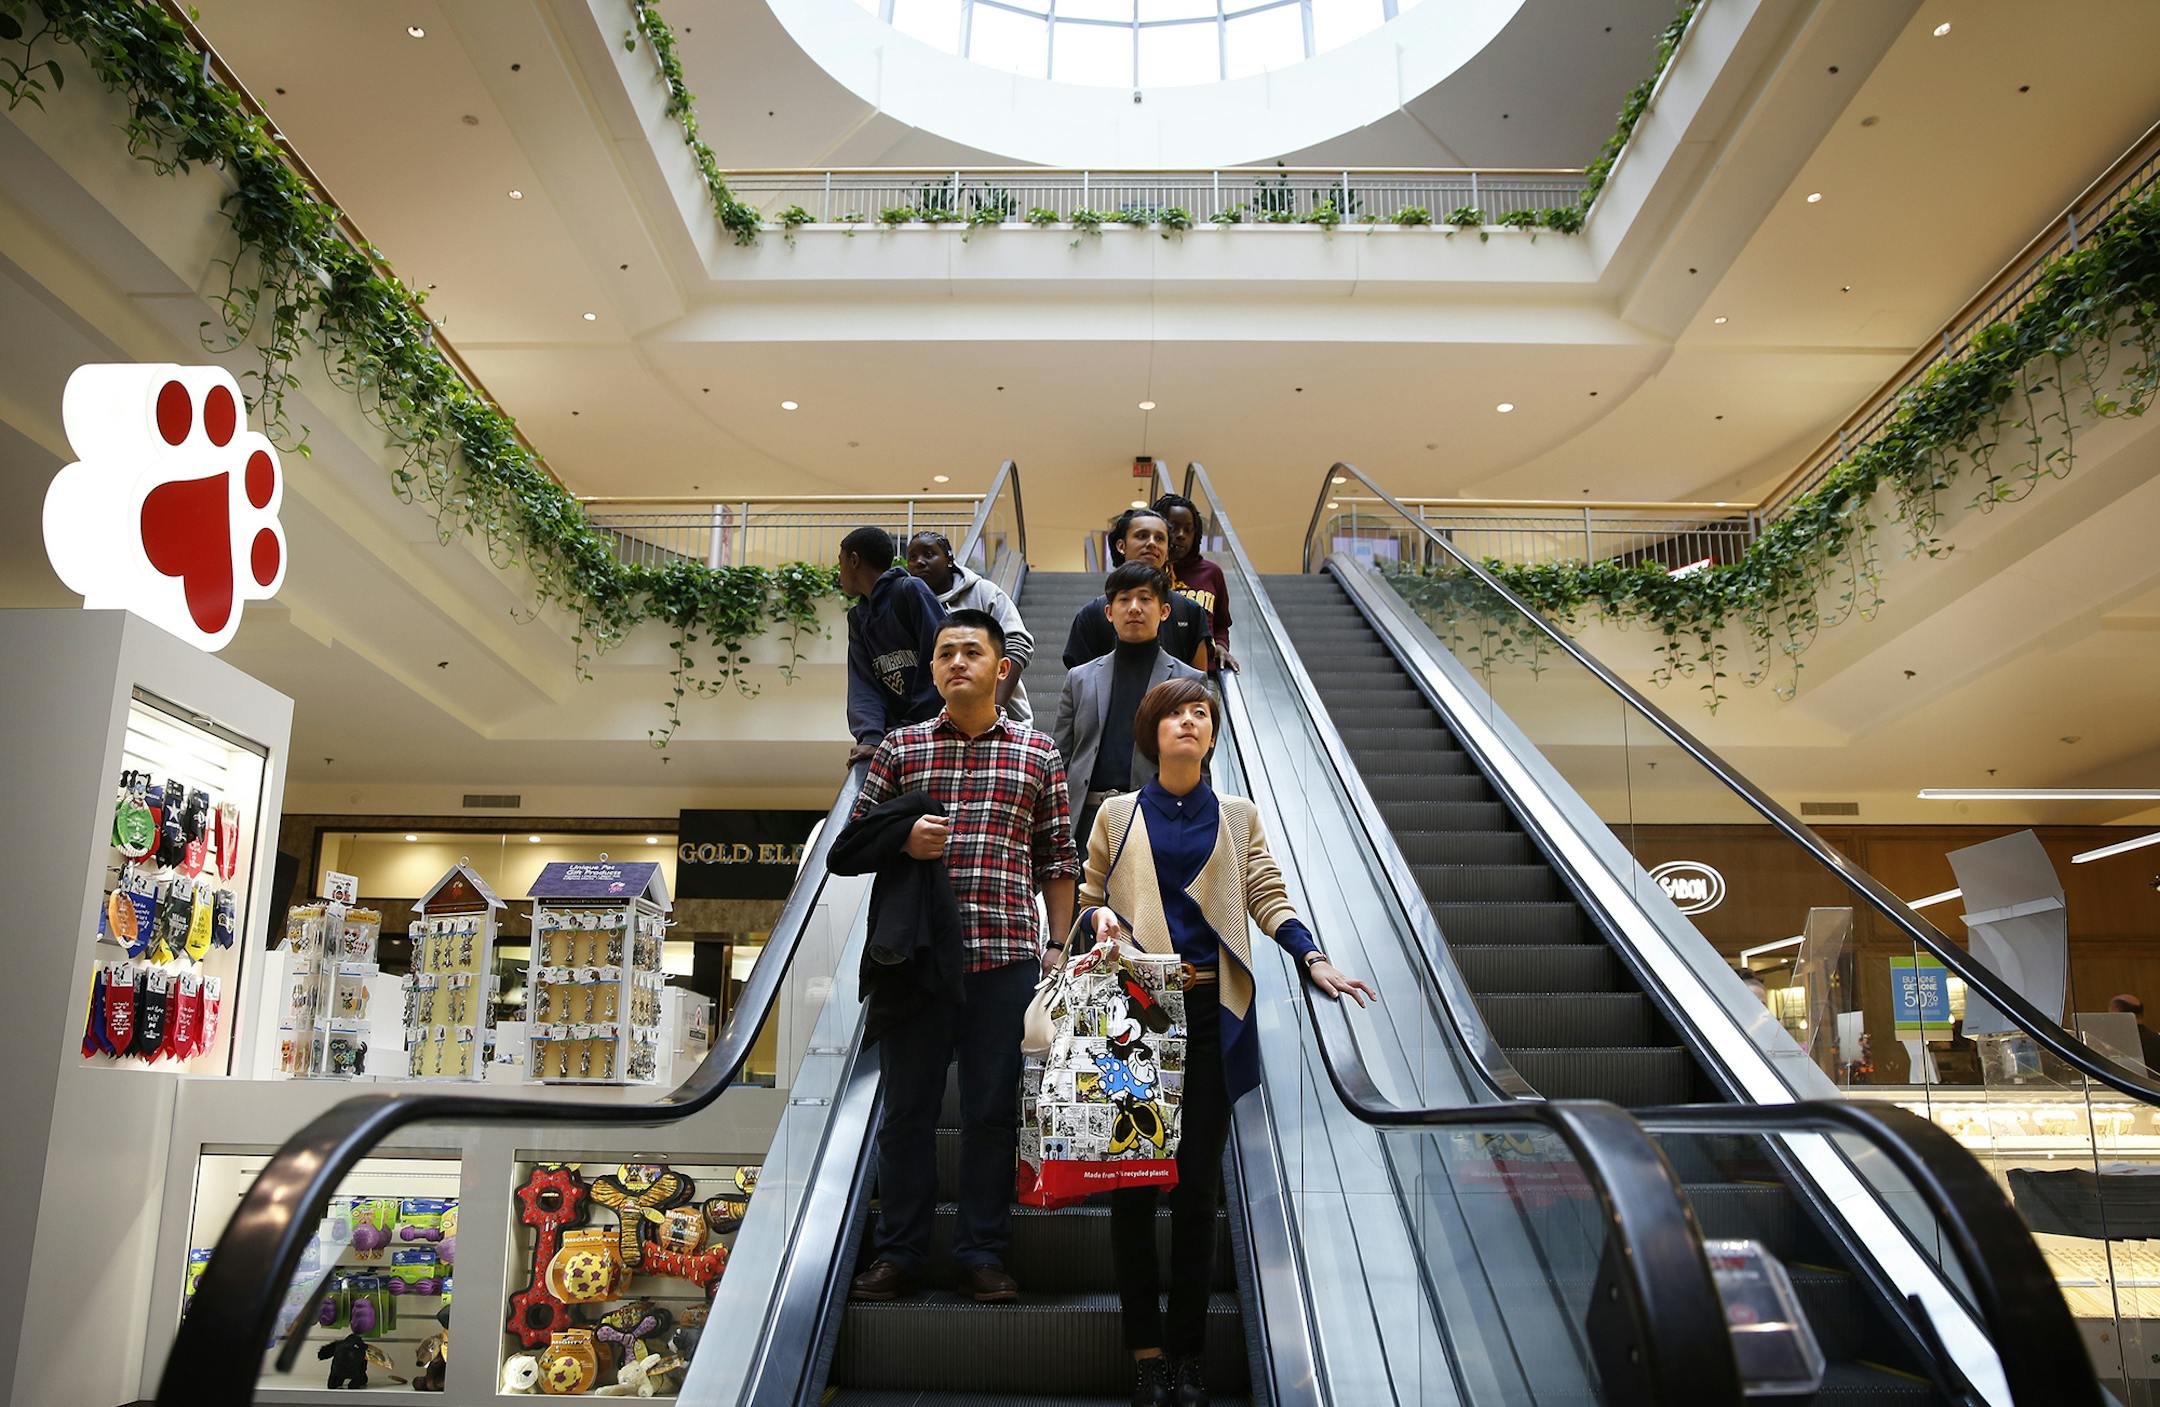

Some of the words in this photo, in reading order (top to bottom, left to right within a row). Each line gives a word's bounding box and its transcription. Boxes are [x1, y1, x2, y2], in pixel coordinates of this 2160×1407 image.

[678, 843, 752, 864] GOLD
[1660, 877, 1708, 900] SABON
[1919, 976, 1937, 984] ONE
[1904, 991, 1939, 1008] 50%
[1083, 1171, 1101, 1179] Made
[1149, 1169, 1169, 1178] plastic
